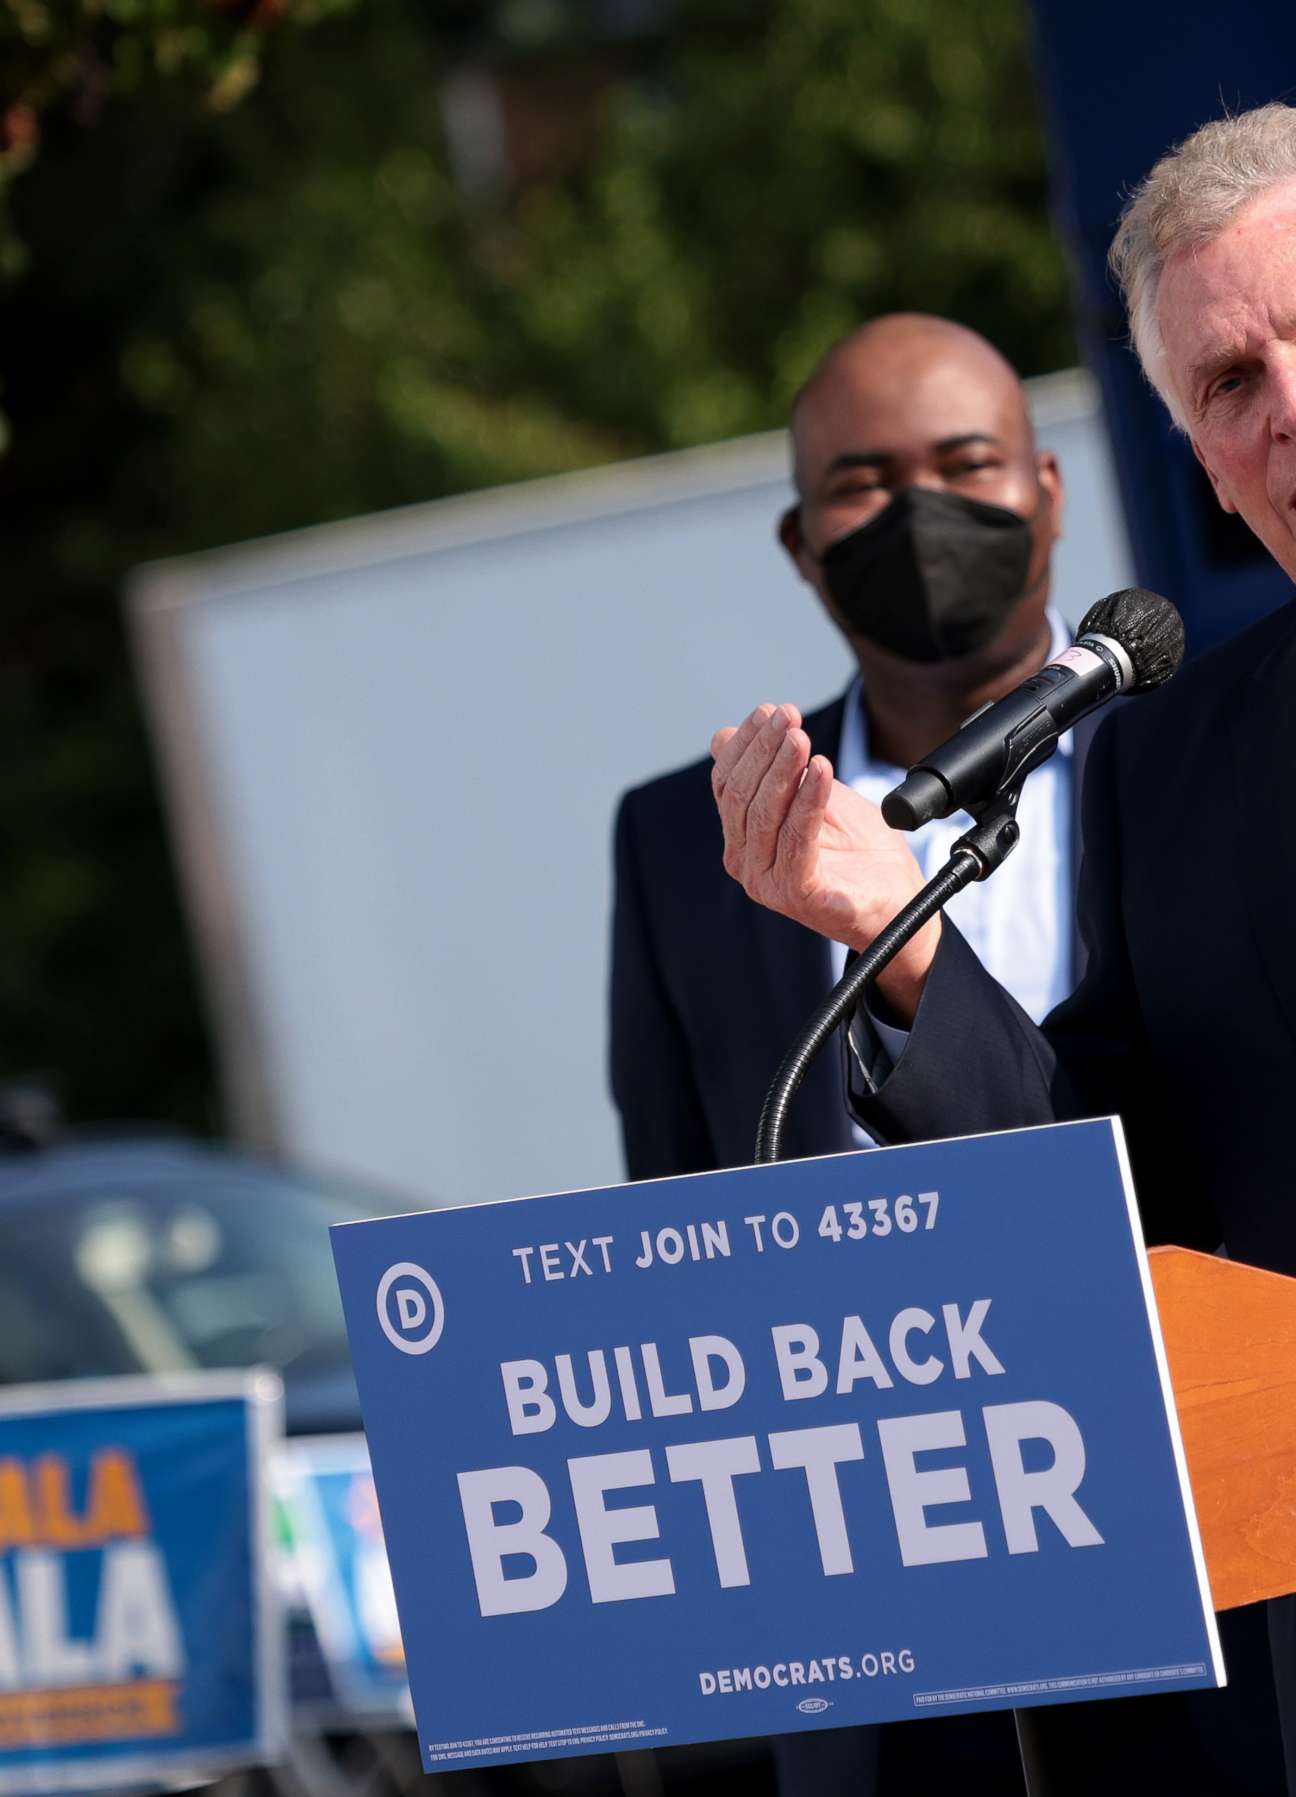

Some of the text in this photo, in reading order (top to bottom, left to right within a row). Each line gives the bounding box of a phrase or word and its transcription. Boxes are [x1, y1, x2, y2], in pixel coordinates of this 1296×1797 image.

[512, 1192, 940, 1284] TEXT JOIN TO 43367
[501, 1299, 1006, 1436] BUILD BACK
[457, 1401, 1105, 1617] BETTER
[699, 1649, 915, 1696] DEMOCRATS.ORG
